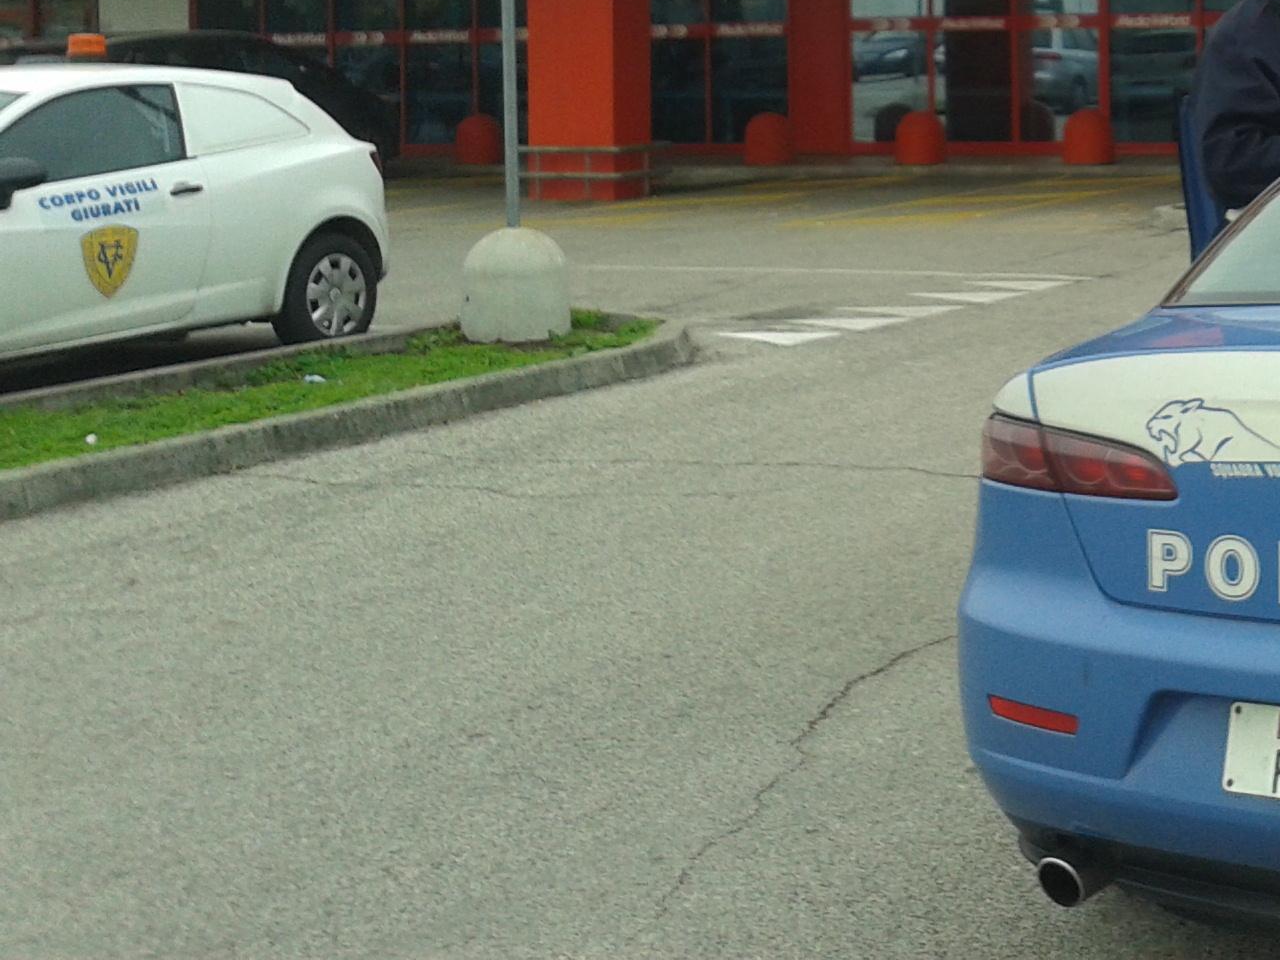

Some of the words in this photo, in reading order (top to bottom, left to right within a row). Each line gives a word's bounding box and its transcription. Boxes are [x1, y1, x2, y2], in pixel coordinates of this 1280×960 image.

[38, 188, 101, 210] CORPO
[104, 177, 159, 198] VIGILI
[70, 197, 141, 221] GIURATI
